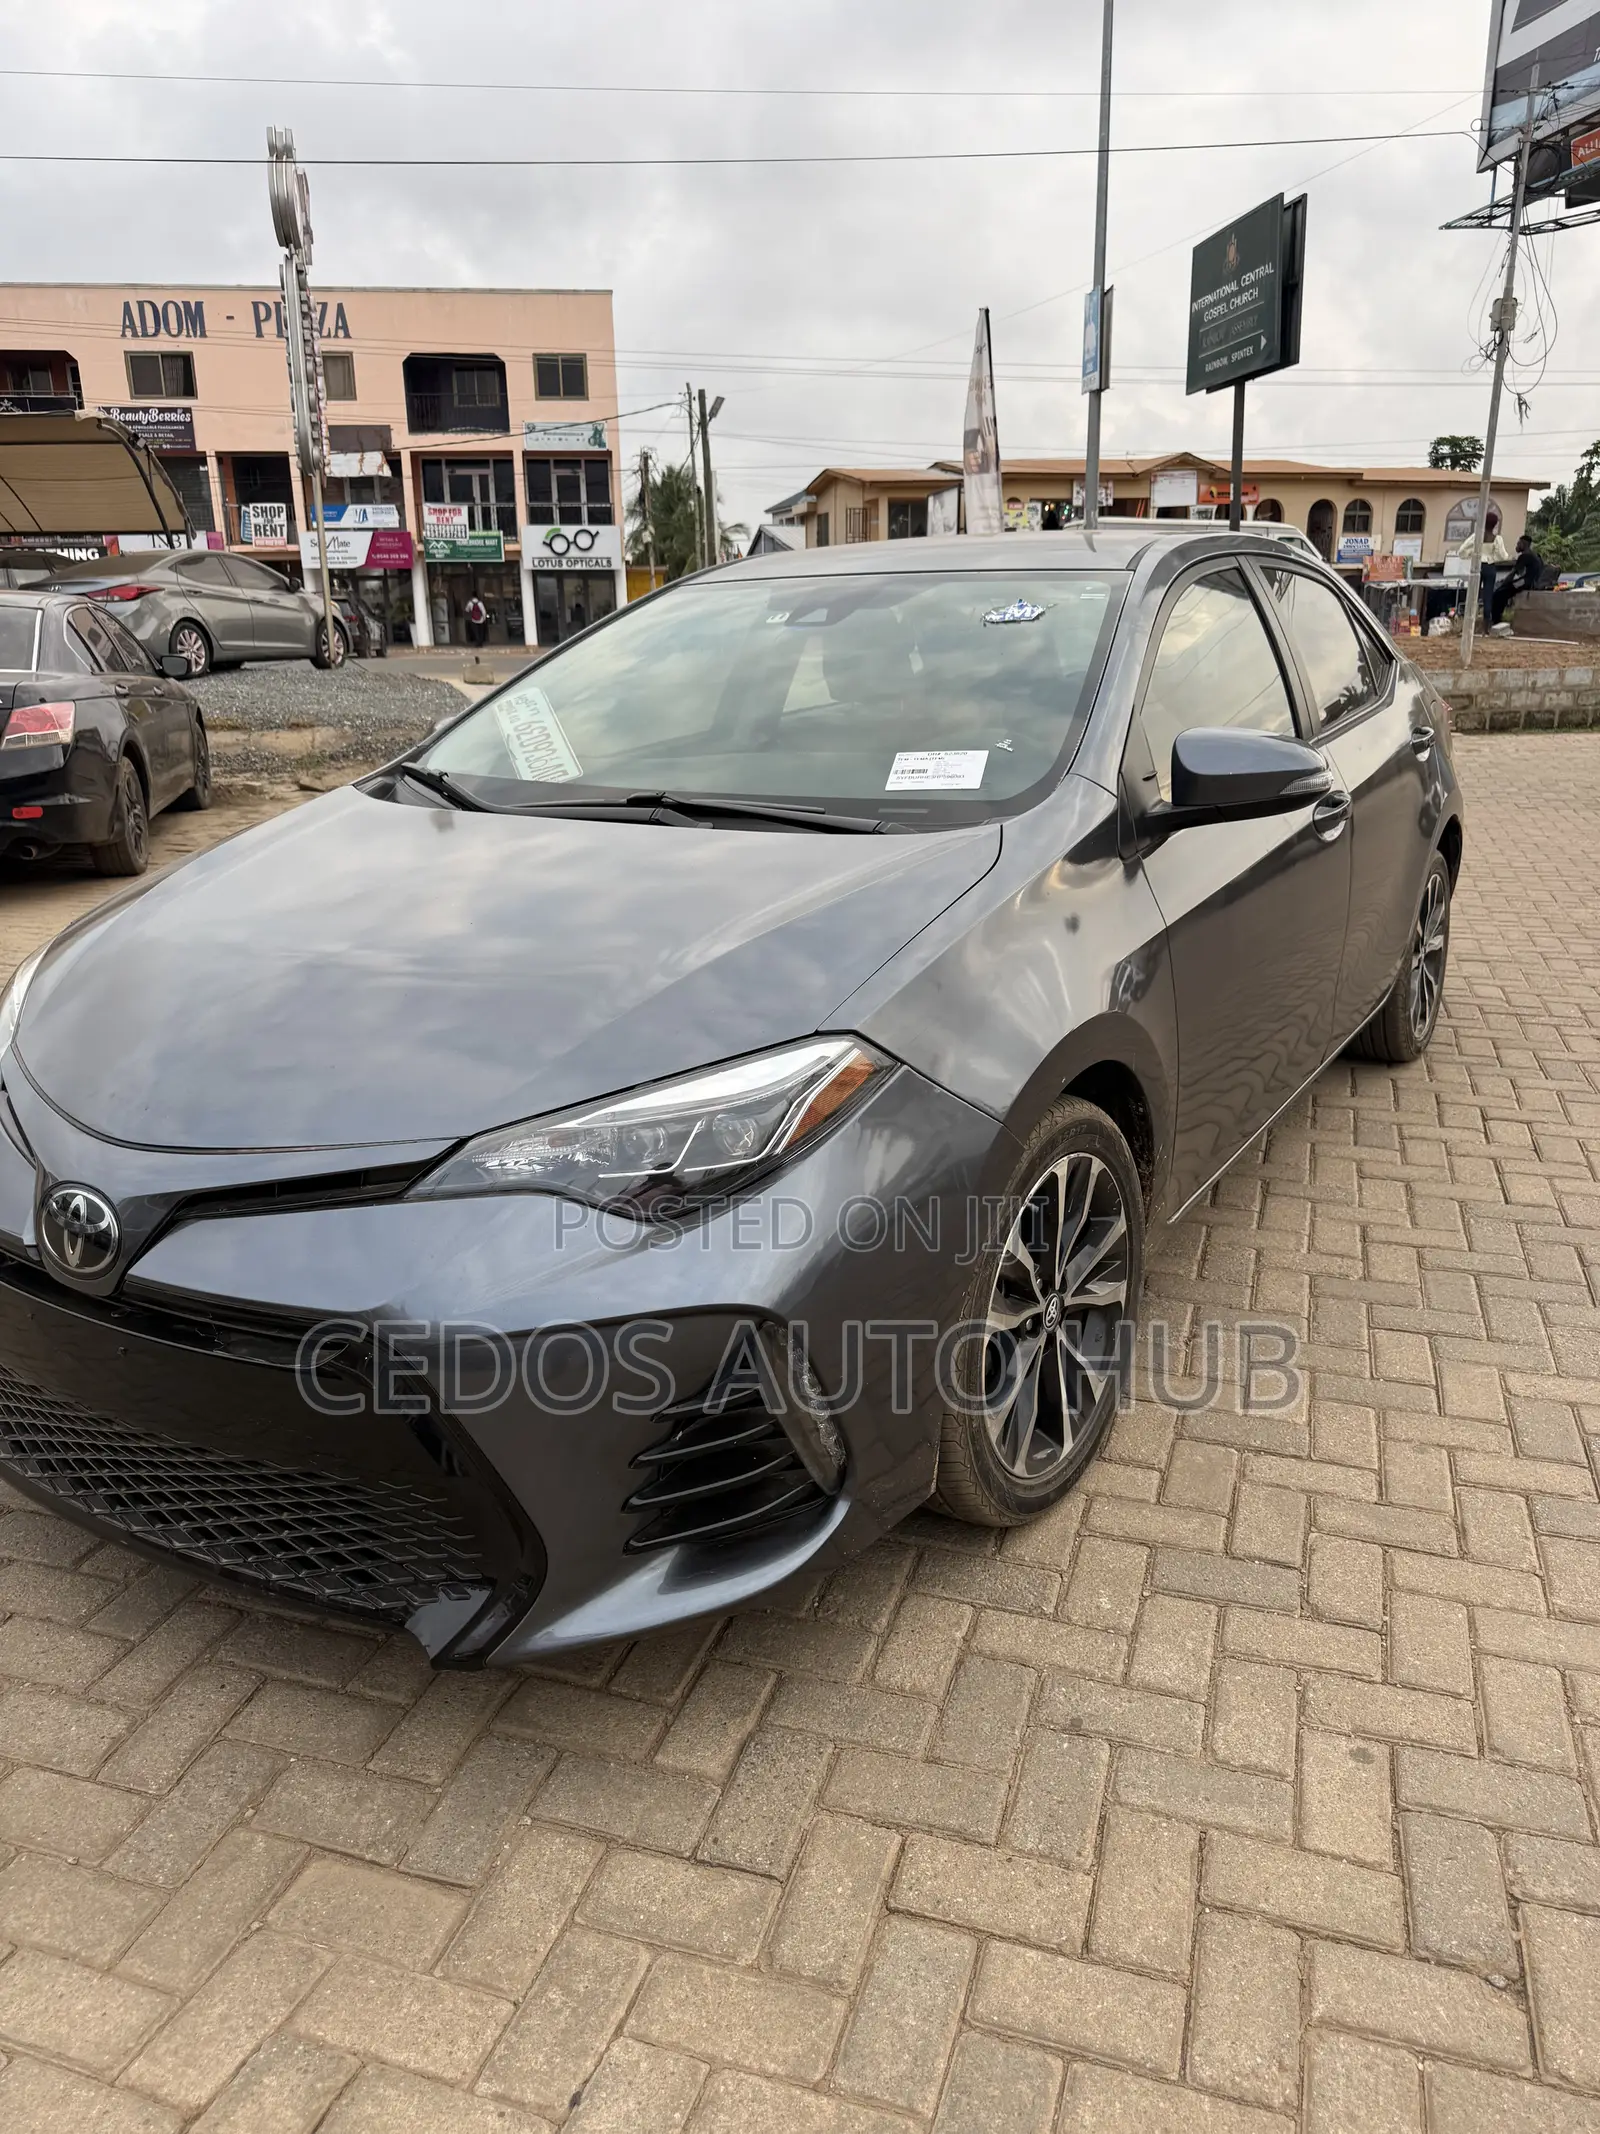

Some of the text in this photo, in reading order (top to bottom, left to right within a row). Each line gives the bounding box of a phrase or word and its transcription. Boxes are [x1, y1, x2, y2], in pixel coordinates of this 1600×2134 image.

[1191, 262, 1275, 313] INTERNATIONAL CENTRAL
[1203, 287, 1259, 322] GOSPEL CHURCH
[121, 300, 208, 338] ADOM
[252, 505, 284, 518] SHOP
[428, 507, 463, 516] SHOP FOR
[435, 516, 454, 525] RENT
[254, 523, 285, 537] RENT
[532, 558, 613, 568] LOTUS OPTICALS
